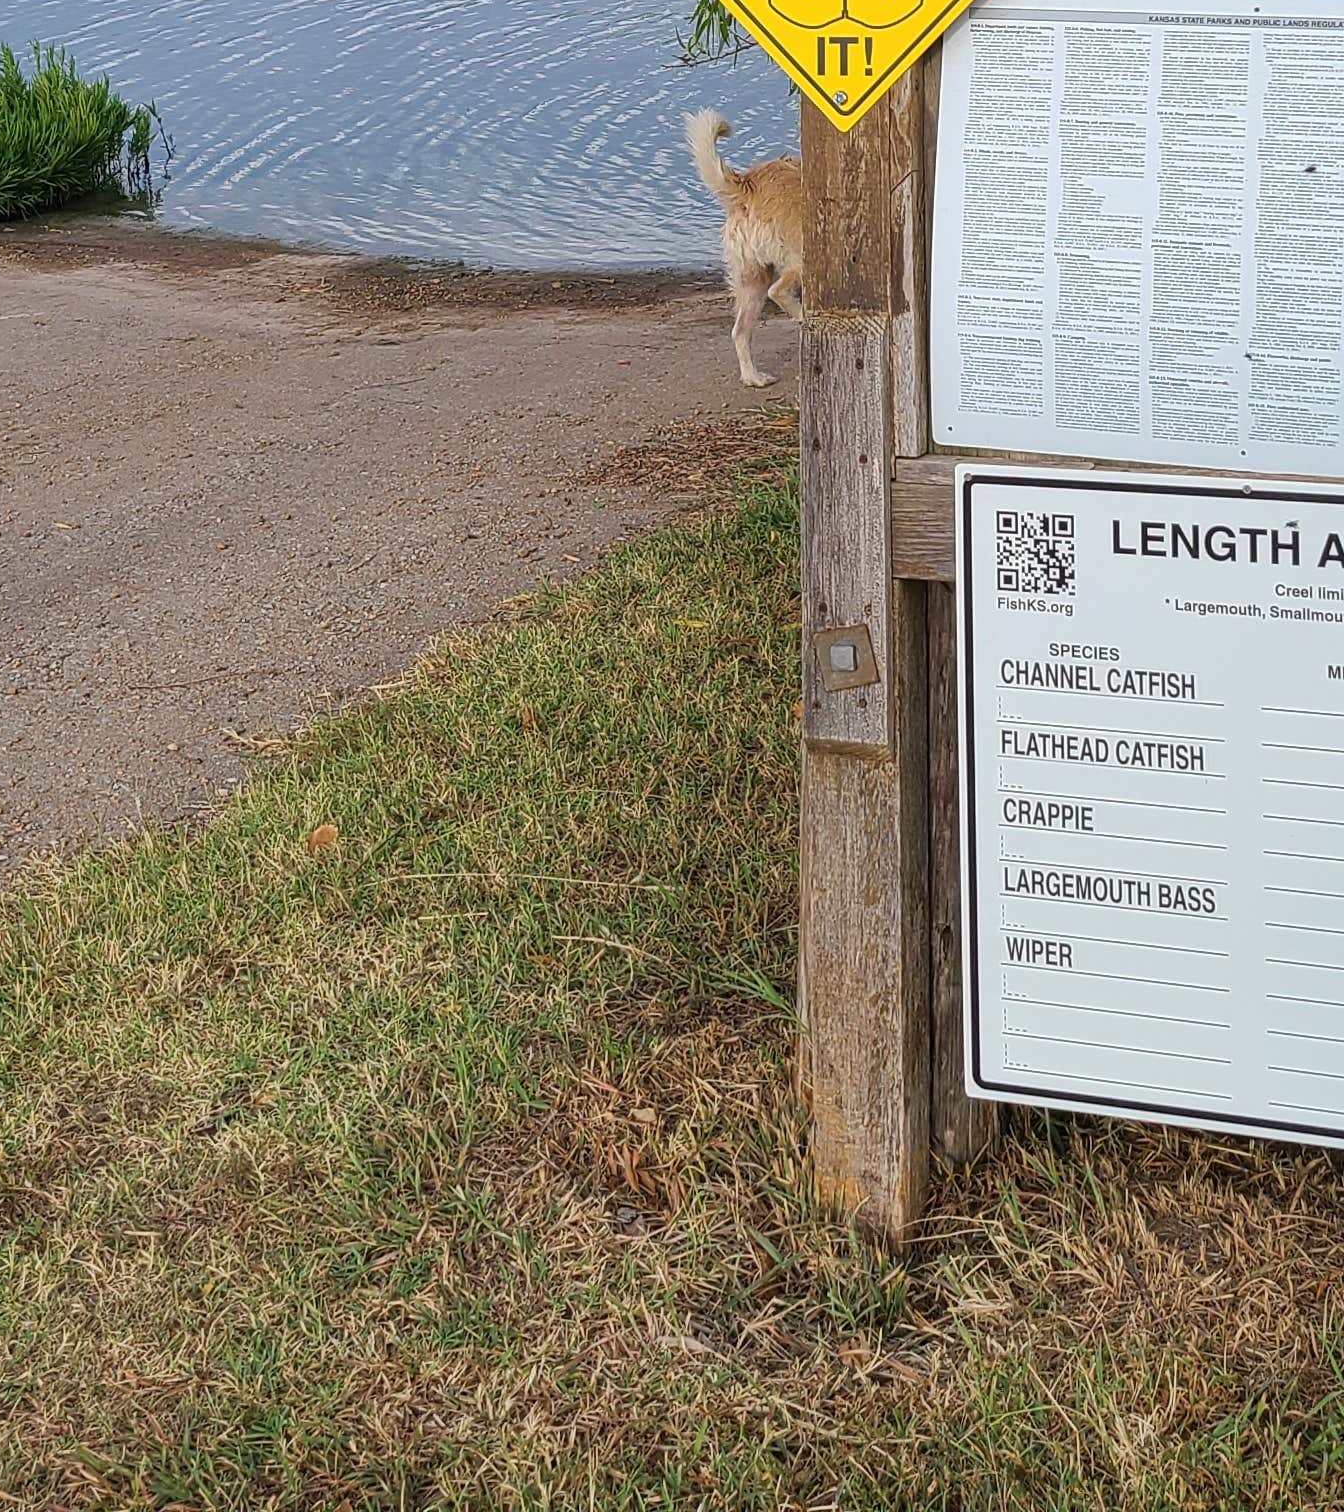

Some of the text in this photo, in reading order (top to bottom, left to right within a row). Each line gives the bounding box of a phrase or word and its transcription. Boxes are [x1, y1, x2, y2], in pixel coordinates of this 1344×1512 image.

[1182, 16, 1204, 24] STATE
[1234, 18, 1251, 26] AND
[1252, 18, 1281, 26] PUBLIC
[816, 36, 874, 76] IT!
[1112, 520, 1300, 566] LENGTH
[997, 598, 1074, 616] FishKS.org
[1275, 584, 1313, 598] Creel
[1174, 599, 1266, 620] Largemouth,
[1049, 642, 1120, 661] SPECIES
[1001, 659, 1196, 700] CHANNEL CATFISH
[1001, 729, 1204, 772] FLATHEAD CATFISH
[1003, 798, 1094, 831] CRAPPIE
[1004, 866, 1216, 914] LARGEMOUTH BASS
[1006, 936, 1072, 968] WIPER
